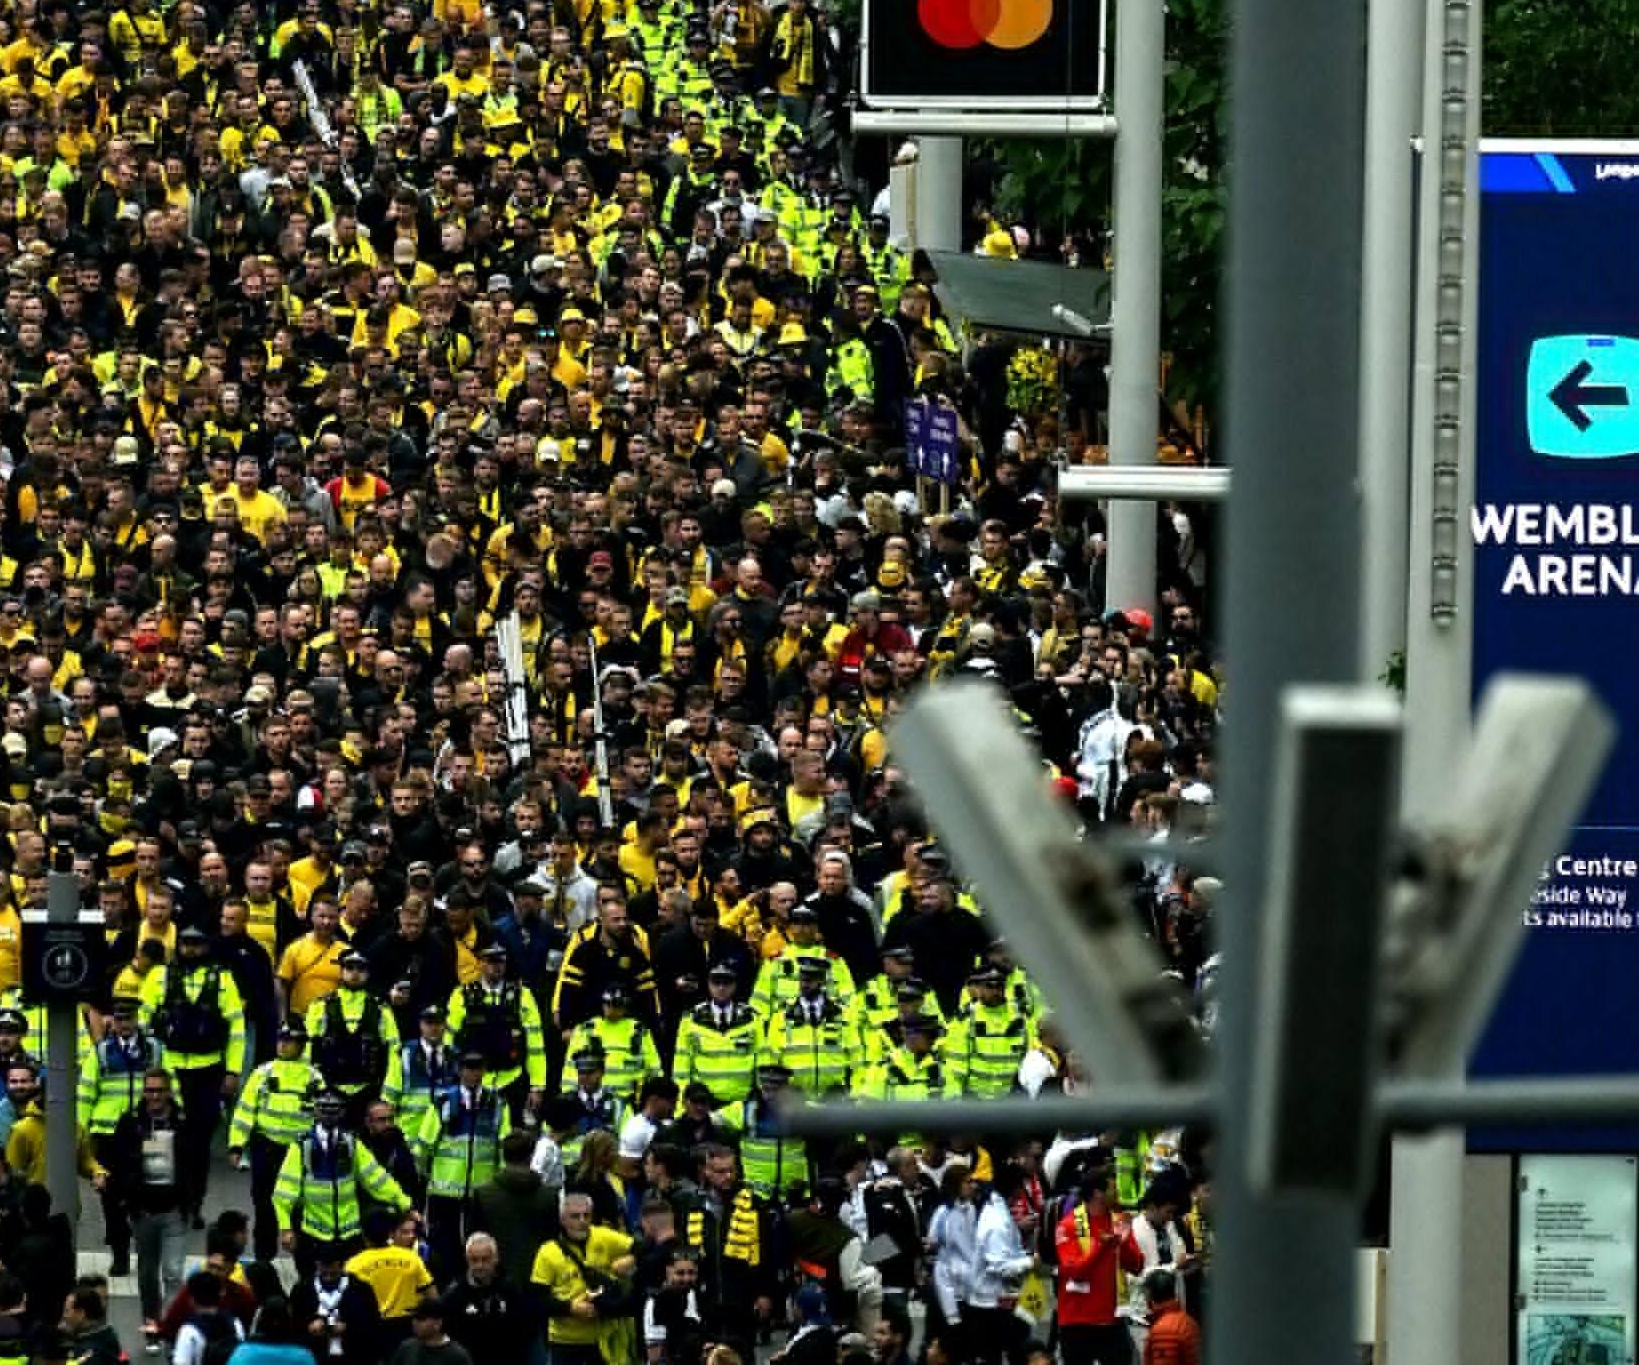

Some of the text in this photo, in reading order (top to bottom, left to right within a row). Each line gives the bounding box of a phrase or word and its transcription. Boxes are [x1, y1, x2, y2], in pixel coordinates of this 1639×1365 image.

[1470, 504, 1639, 545] WEMBL
[1501, 555, 1639, 596] AREN
[1555, 855, 1638, 877] Centre
[1585, 885, 1627, 909] Way
[1547, 908, 1633, 928] available
